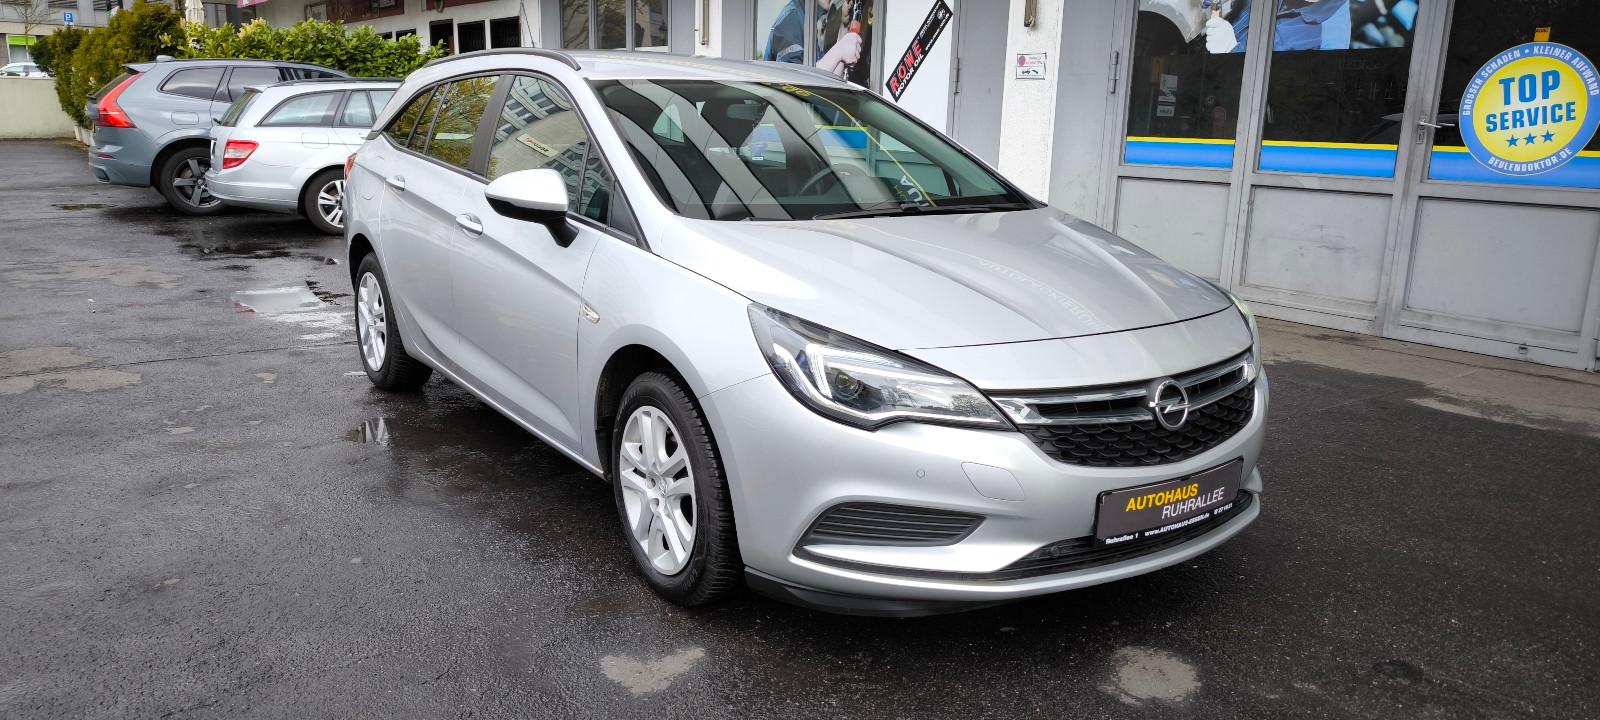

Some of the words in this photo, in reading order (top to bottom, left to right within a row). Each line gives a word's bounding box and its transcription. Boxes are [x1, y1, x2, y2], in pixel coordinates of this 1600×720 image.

[890, 38, 922, 94] ROWE
[896, 68, 914, 97] MOTOR
[914, 53, 924, 67] OIL
[1463, 78, 1483, 116] GROSSER
[1481, 49, 1521, 78] SCHADEN
[1533, 45, 1573, 61] KLEINER
[1571, 57, 1600, 96] AUFWAND
[1498, 69, 1561, 106] TOP
[1485, 101, 1577, 133] SERVICE
[1488, 147, 1573, 172] BEULENDOKTOR.DE
[1125, 483, 1199, 512] AUTOHAUS
[1161, 487, 1225, 519] RUHRALLEE
[1105, 535, 1134, 545] Ruhrallee
